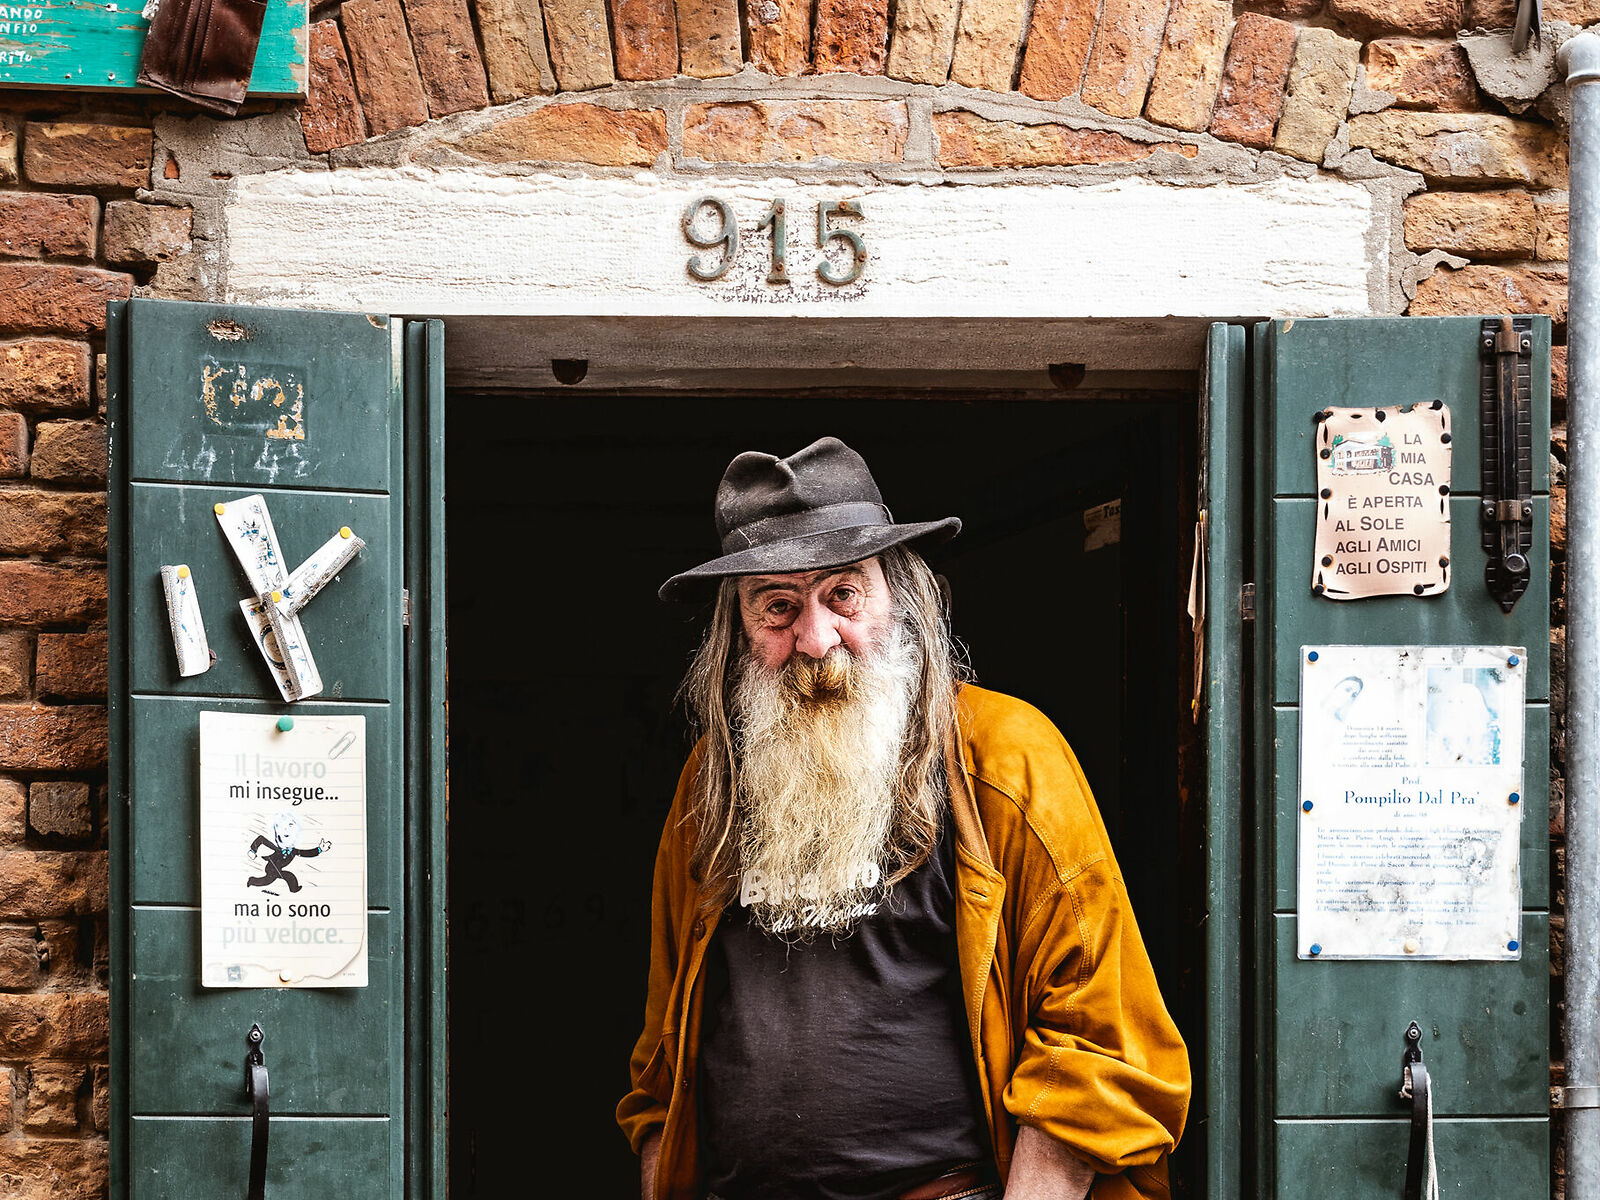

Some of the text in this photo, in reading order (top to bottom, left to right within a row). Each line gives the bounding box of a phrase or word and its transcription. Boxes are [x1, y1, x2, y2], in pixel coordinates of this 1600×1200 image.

[682, 196, 867, 286] 915
[1404, 434, 1422, 445] LA
[1401, 453, 1426, 464] MIA
[1389, 473, 1435, 486] CASA
[1348, 495, 1423, 509] È APERTA
[1335, 520, 1355, 532] AL
[1335, 540, 1371, 554] AGLI
[1336, 562, 1371, 575] AGLI
[256, 753, 327, 779] lavoro
[229, 781, 339, 806] mi insegue...
[1344, 788, 1411, 807] Pompilio
[1418, 789, 1442, 804] Dal
[234, 899, 331, 918] ma io sono
[222, 922, 344, 949] più veloce.
